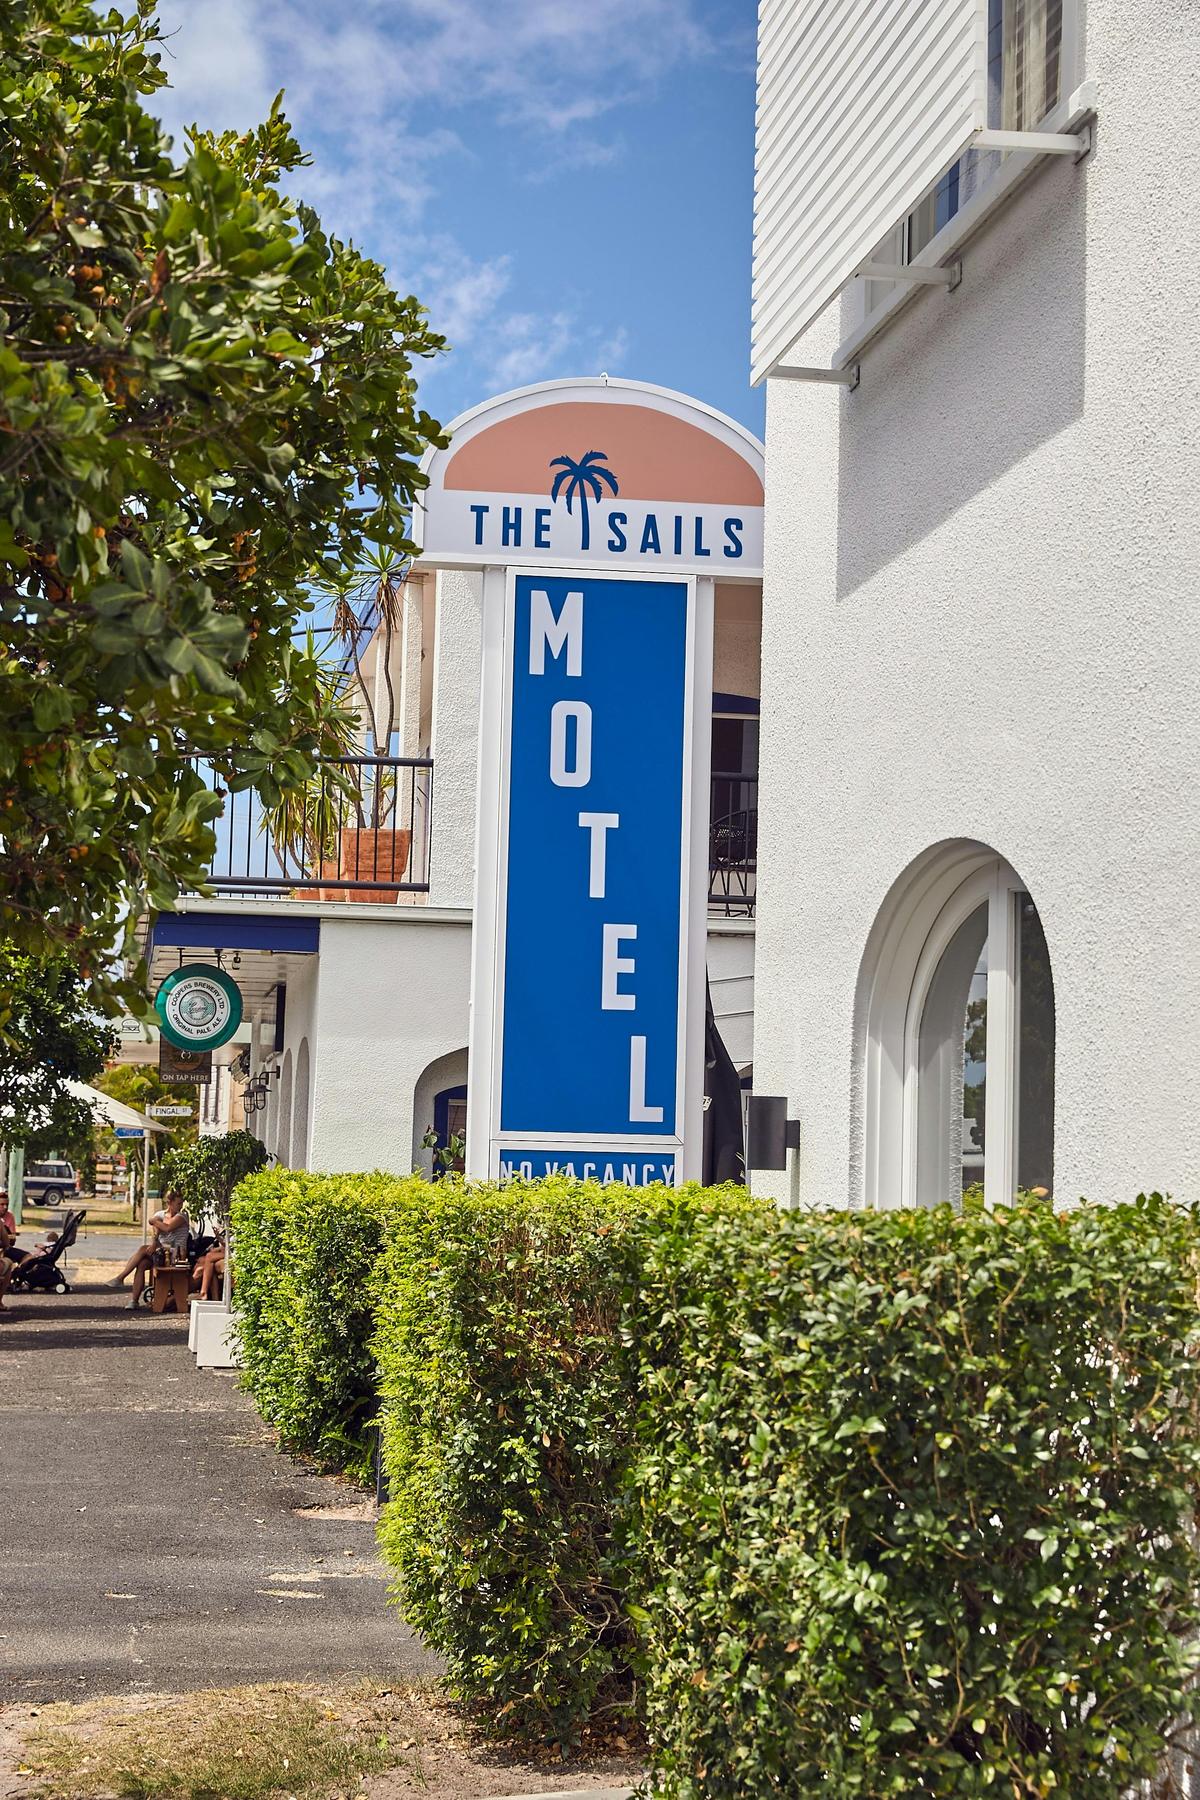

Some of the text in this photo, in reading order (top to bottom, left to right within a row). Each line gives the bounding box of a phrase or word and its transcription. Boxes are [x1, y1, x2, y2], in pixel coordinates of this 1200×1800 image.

[470, 504, 743, 558] THE SAILS
[529, 590, 664, 1123] MOTEL
[171, 983, 192, 1006] COOPERS
[194, 981, 220, 998] BREWERY
[217, 997, 225, 1009] LTD
[173, 1014, 222, 1035] ORIGINAL PALE ALE
